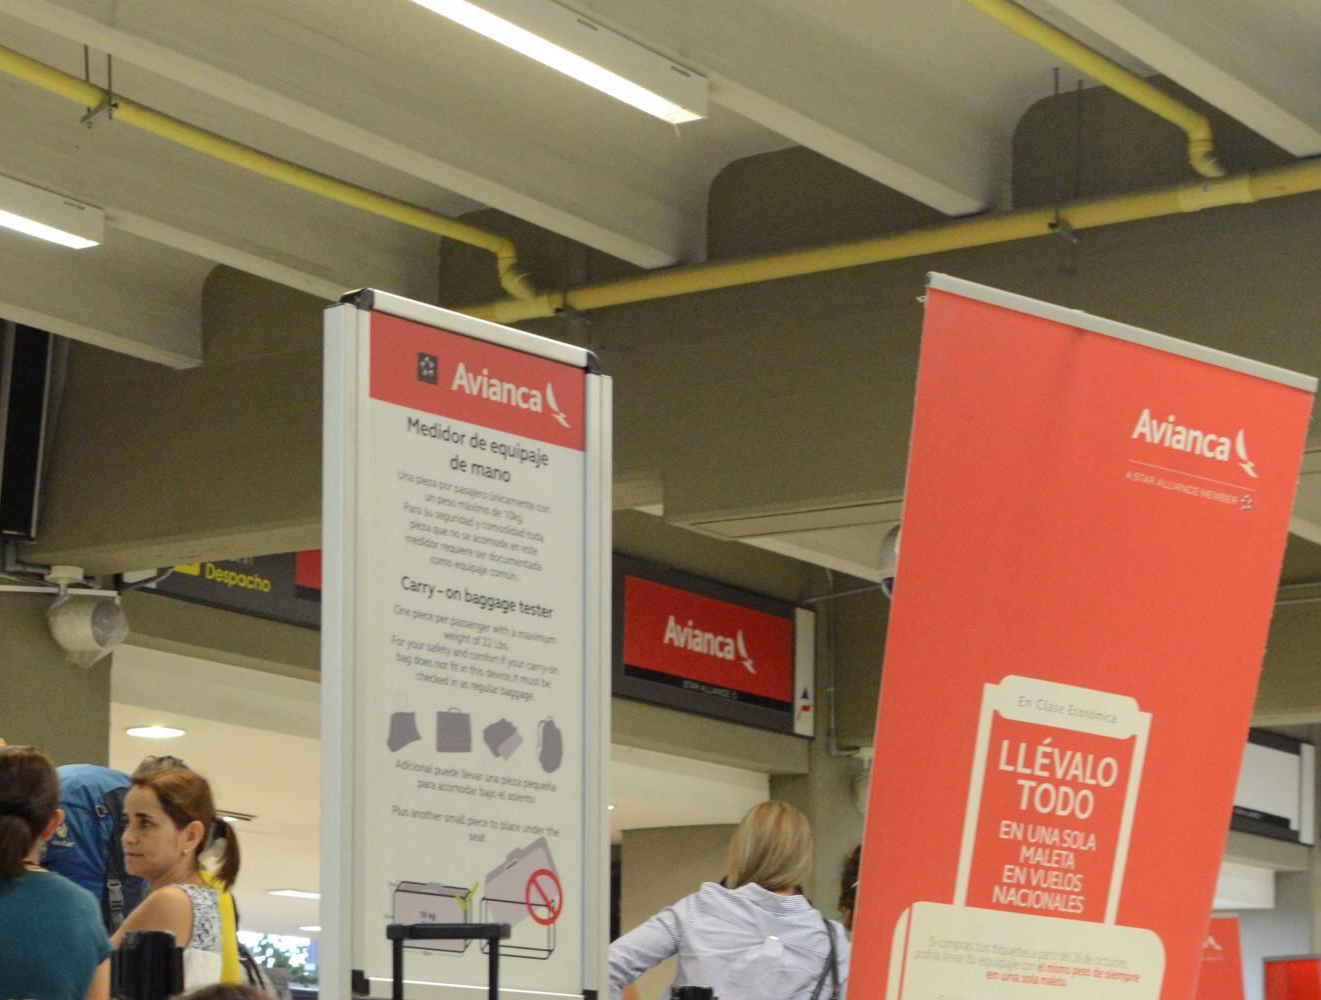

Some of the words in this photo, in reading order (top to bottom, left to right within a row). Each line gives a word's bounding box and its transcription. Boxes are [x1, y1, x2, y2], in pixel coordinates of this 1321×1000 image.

[451, 362, 543, 413] Avianca
[407, 416, 466, 445] Medidor
[470, 434, 487, 451] de
[490, 441, 549, 468] equipaje
[1131, 408, 1230, 462] Avianca
[450, 454, 467, 472] de
[471, 463, 511, 482] mano
[205, 562, 272, 593] Despacho
[401, 576, 435, 599] Carry
[445, 586, 461, 600] on
[464, 587, 516, 614] baggage
[519, 600, 554, 619] tester
[663, 615, 735, 660] Avianca
[1017, 696, 1032, 708] En
[1037, 698, 1065, 715] Clase
[998, 737, 1119, 788] LLÉVALO
[1017, 779, 1095, 820] TODO
[998, 820, 1024, 841] EN
[1027, 824, 1061, 846] UNA
[1062, 829, 1097, 851] SOLA
[1019, 845, 1075, 870] MALETA
[1002, 864, 1026, 885] EN
[1030, 867, 1083, 892] VUELOS
[992, 885, 1085, 914] NACIONALES
